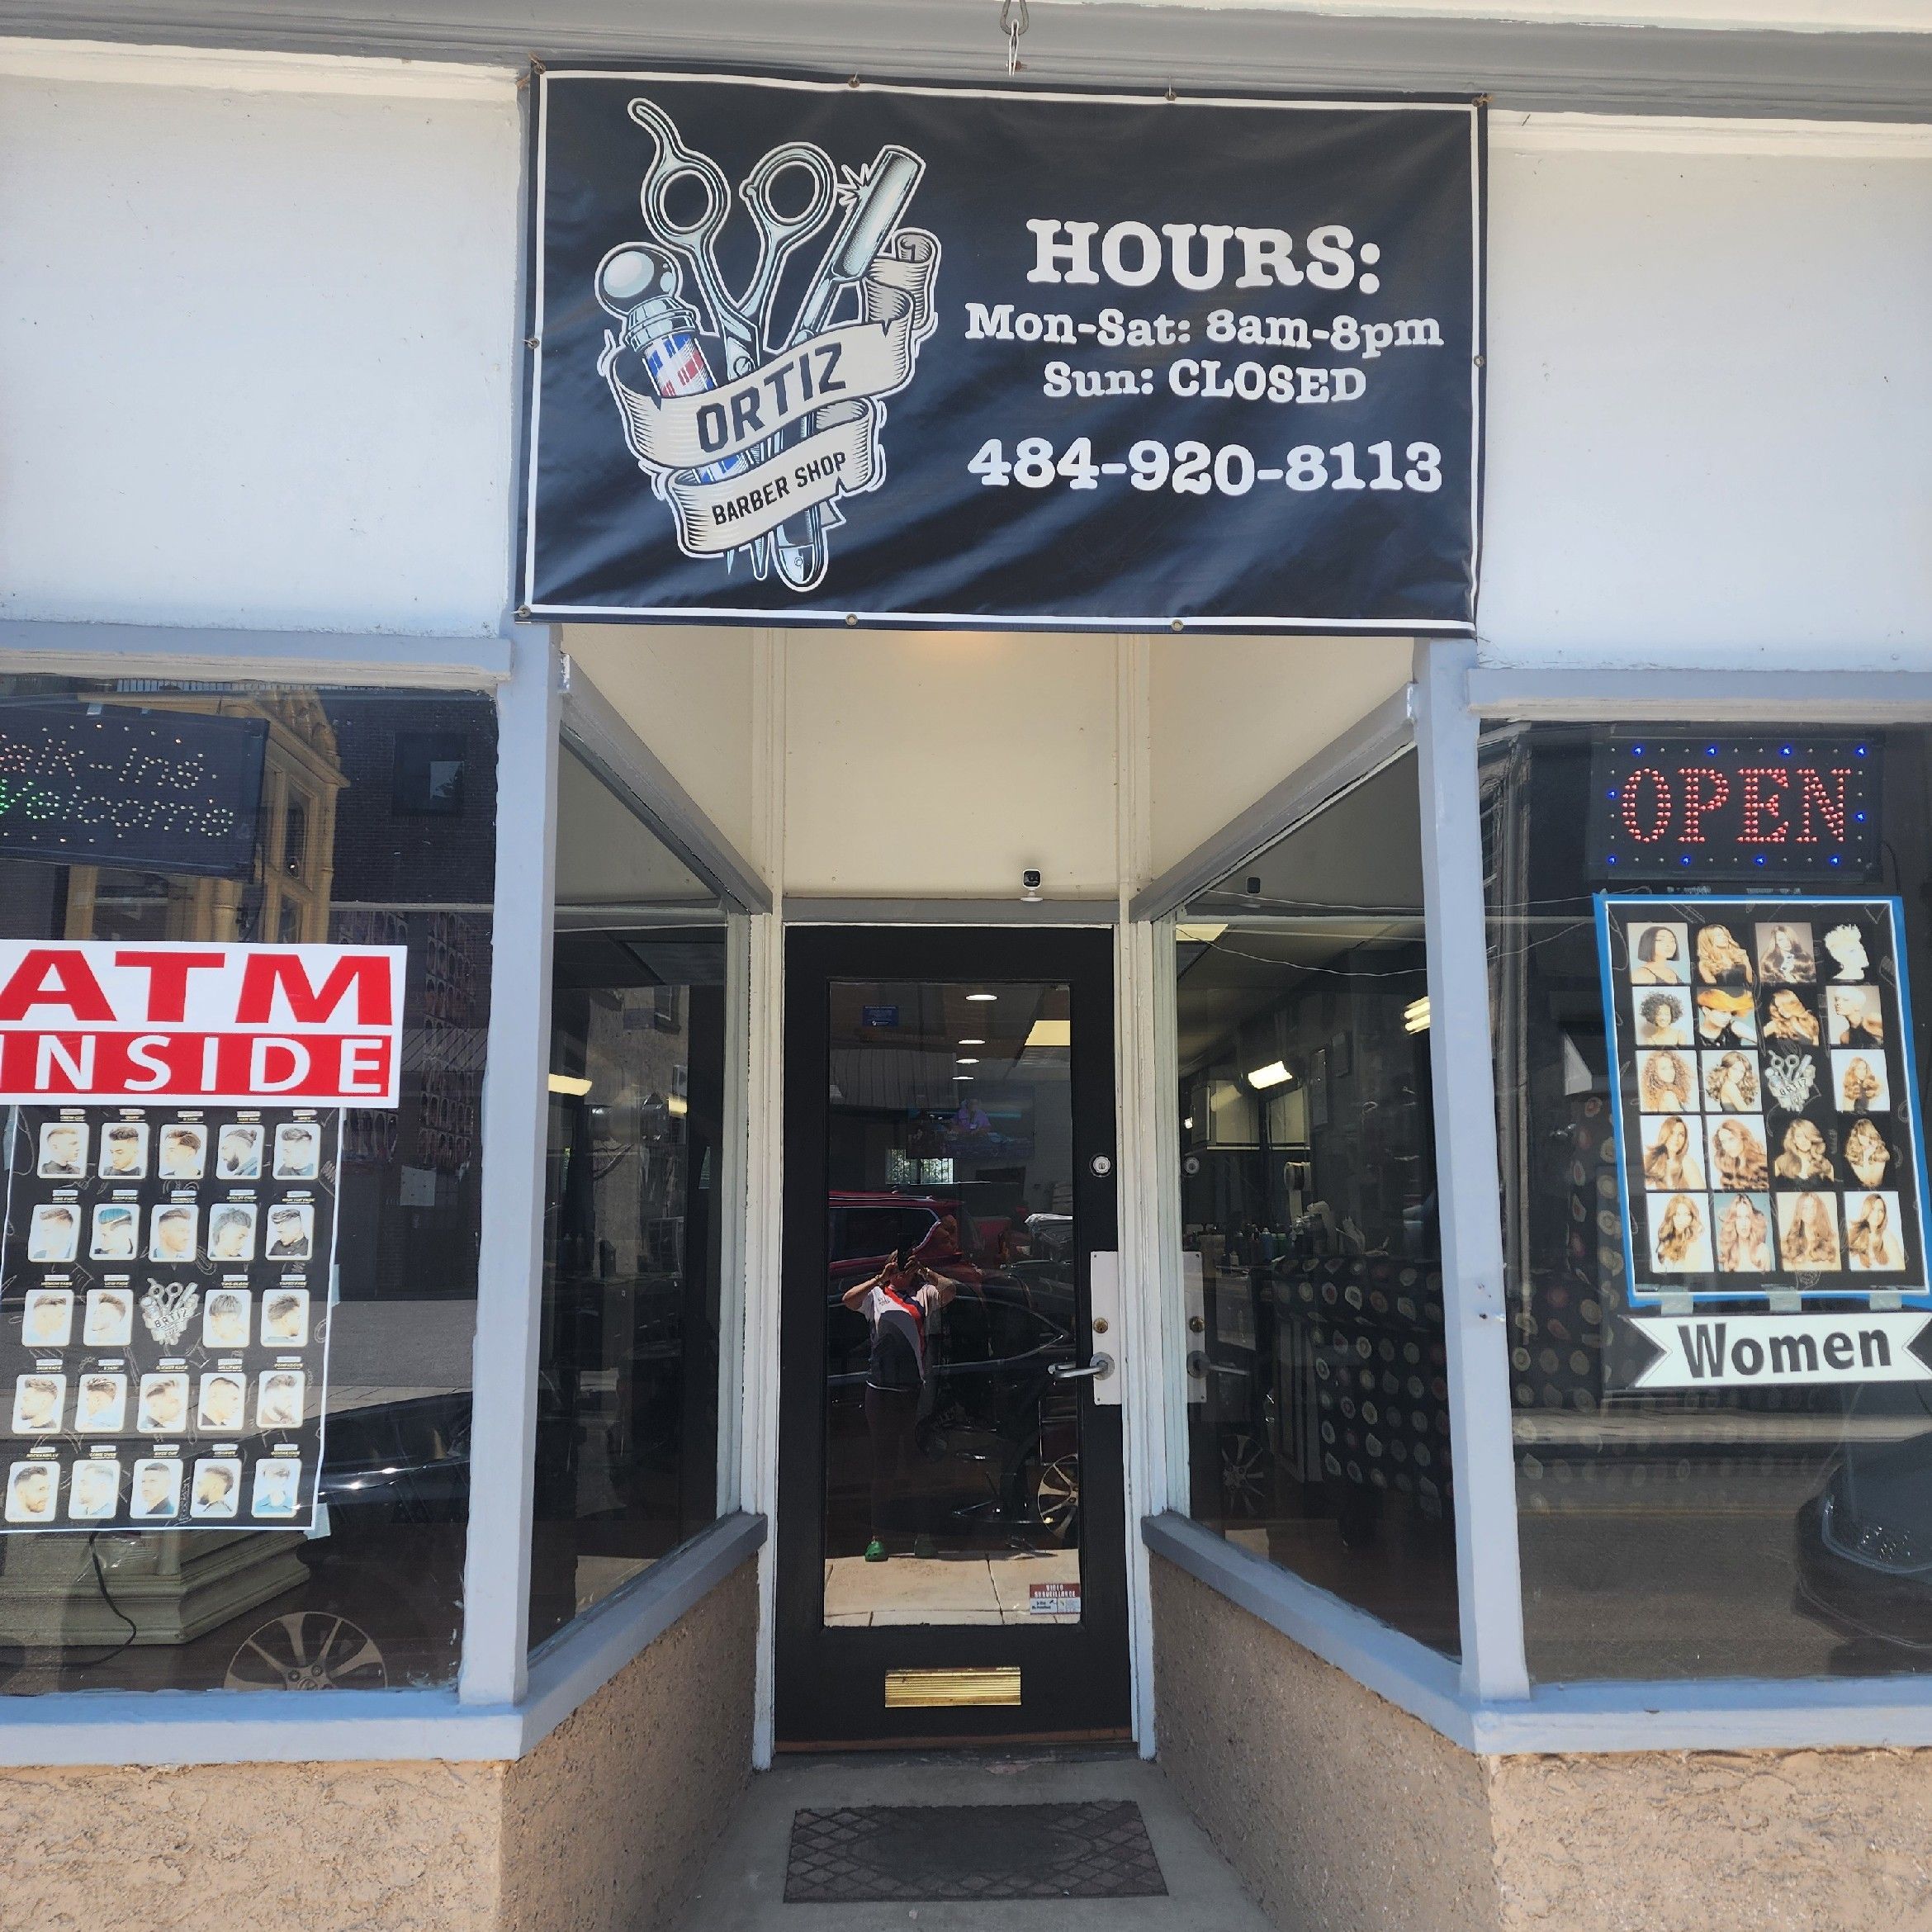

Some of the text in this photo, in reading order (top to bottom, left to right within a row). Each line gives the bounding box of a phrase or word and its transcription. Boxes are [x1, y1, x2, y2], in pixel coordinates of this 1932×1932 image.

[1026, 218, 1380, 294] HOURS:
[964, 302, 1444, 358] Mon-Sat: 8am-8pm
[697, 341, 847, 452] ORTIZ
[1043, 358, 1367, 404] Sun: CLOSED
[713, 451, 848, 526] BARBER SHOP
[967, 437, 1442, 497] 484-920-8113
[0, 738, 204, 789] alk-Ins
[1621, 767, 1852, 843] OPEN
[0, 949, 393, 1025] ATM
[0, 1035, 383, 1094] NSIDE
[1677, 1322, 1892, 1378] Women
